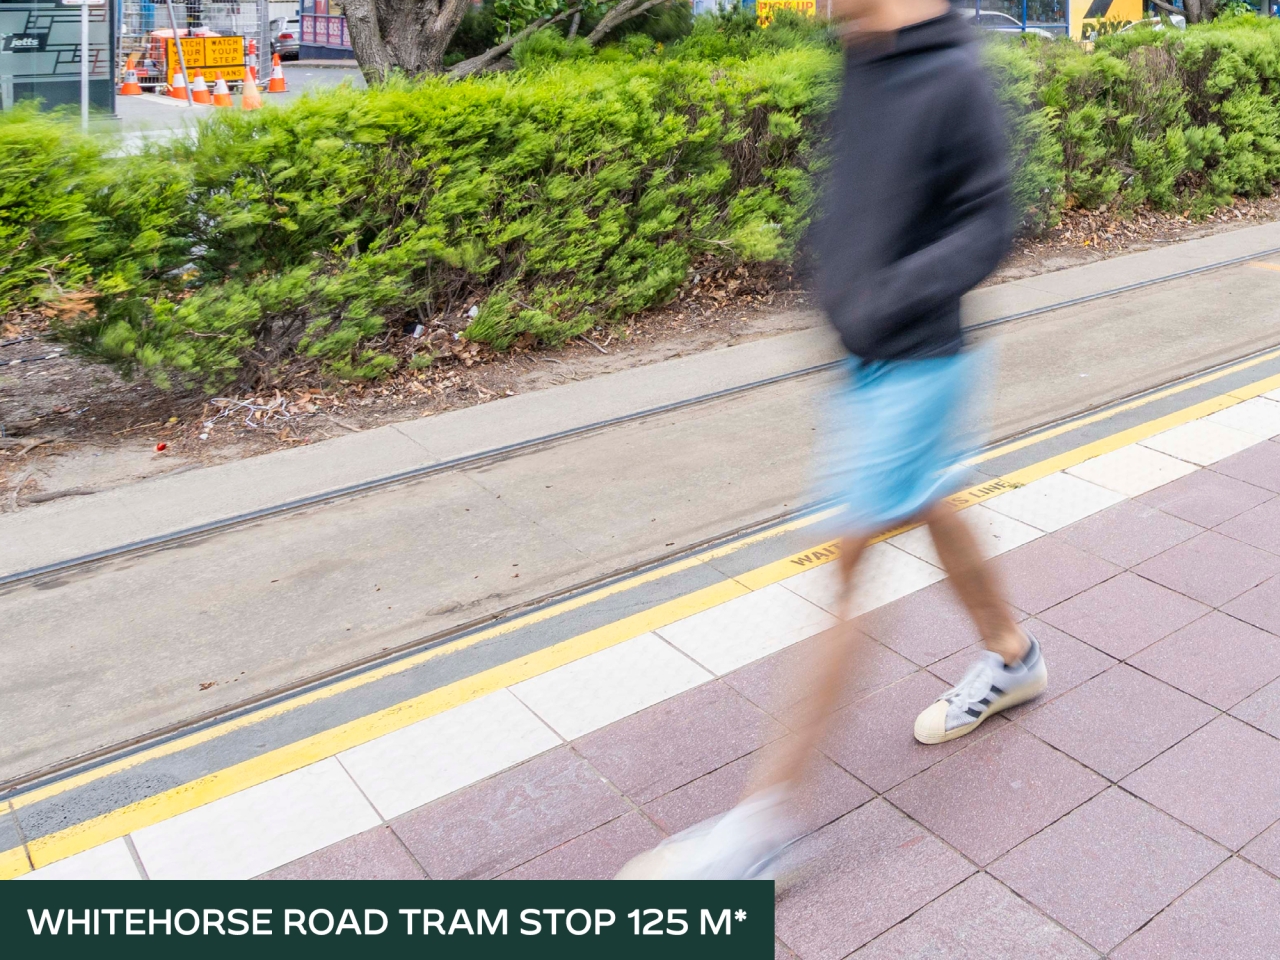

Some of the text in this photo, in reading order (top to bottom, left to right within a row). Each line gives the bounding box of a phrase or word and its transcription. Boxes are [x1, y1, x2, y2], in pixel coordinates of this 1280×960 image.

[10, 37, 39, 48] jetts
[174, 58, 200, 66] SEP
[213, 56, 237, 64] STEP
[790, 542, 842, 567] WAIT
[968, 480, 1009, 499] LINE
